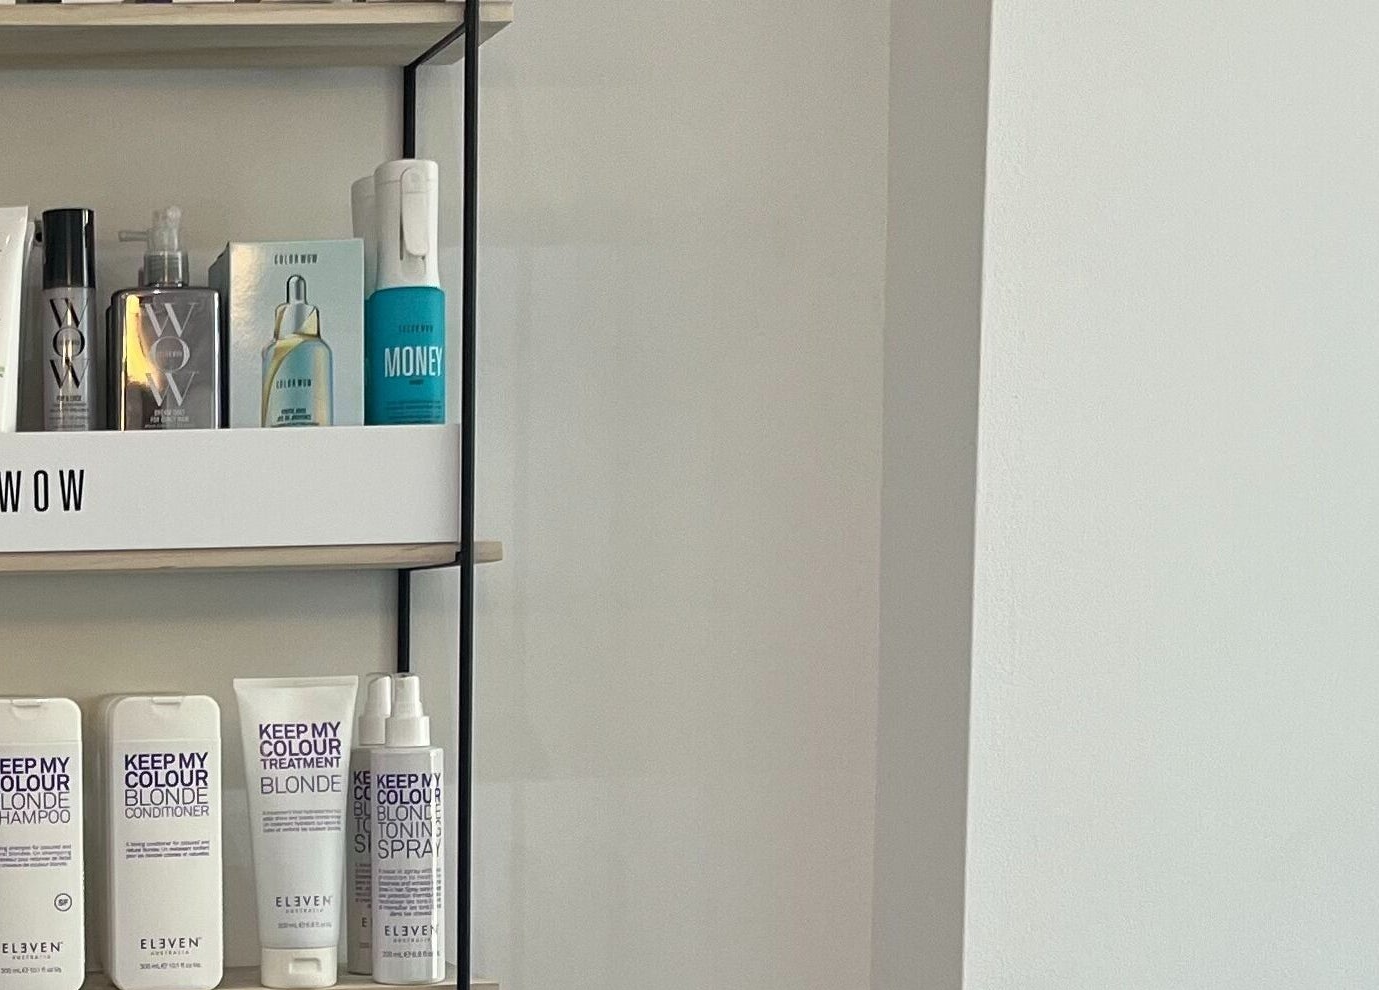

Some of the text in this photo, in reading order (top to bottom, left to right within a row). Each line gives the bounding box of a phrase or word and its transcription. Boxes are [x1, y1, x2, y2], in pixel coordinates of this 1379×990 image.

[384, 345, 442, 378] MONEY
[258, 721, 341, 740] KEEP MY
[259, 738, 342, 757] COLOUR
[40, 757, 70, 774] MY
[124, 752, 209, 771] KEEP MY
[260, 757, 341, 770] TREATMENT
[124, 770, 209, 788] COLOUR
[260, 774, 342, 795] BLONDE
[376, 773, 441, 789] KEEP MY
[125, 787, 209, 807] BLONDE
[376, 788, 441, 805] COLOUR
[124, 805, 209, 819] CONDITIONER
[377, 839, 441, 859] SPRAY
